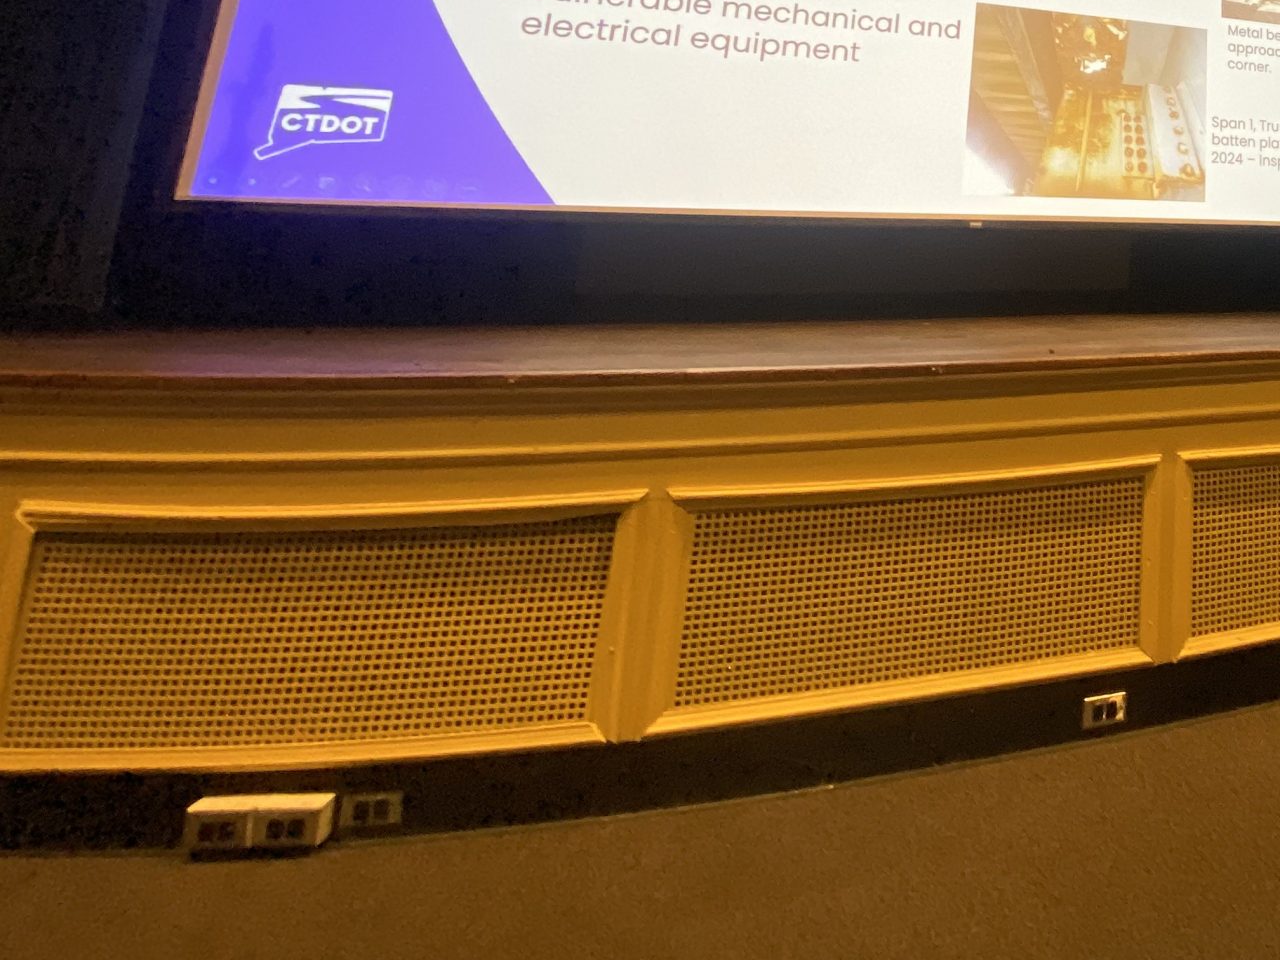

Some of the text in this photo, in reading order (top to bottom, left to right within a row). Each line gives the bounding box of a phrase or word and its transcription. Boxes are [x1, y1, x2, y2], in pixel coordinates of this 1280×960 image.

[908, 17, 962, 40] and
[1227, 24, 1263, 39] Metal
[520, 13, 861, 63] electrical equipment
[1227, 59, 1273, 74] corner.
[281, 113, 379, 135] CTDOT
[1211, 116, 1246, 131] Span
[1211, 133, 1256, 148] batten
[1211, 152, 1244, 165] 2024
